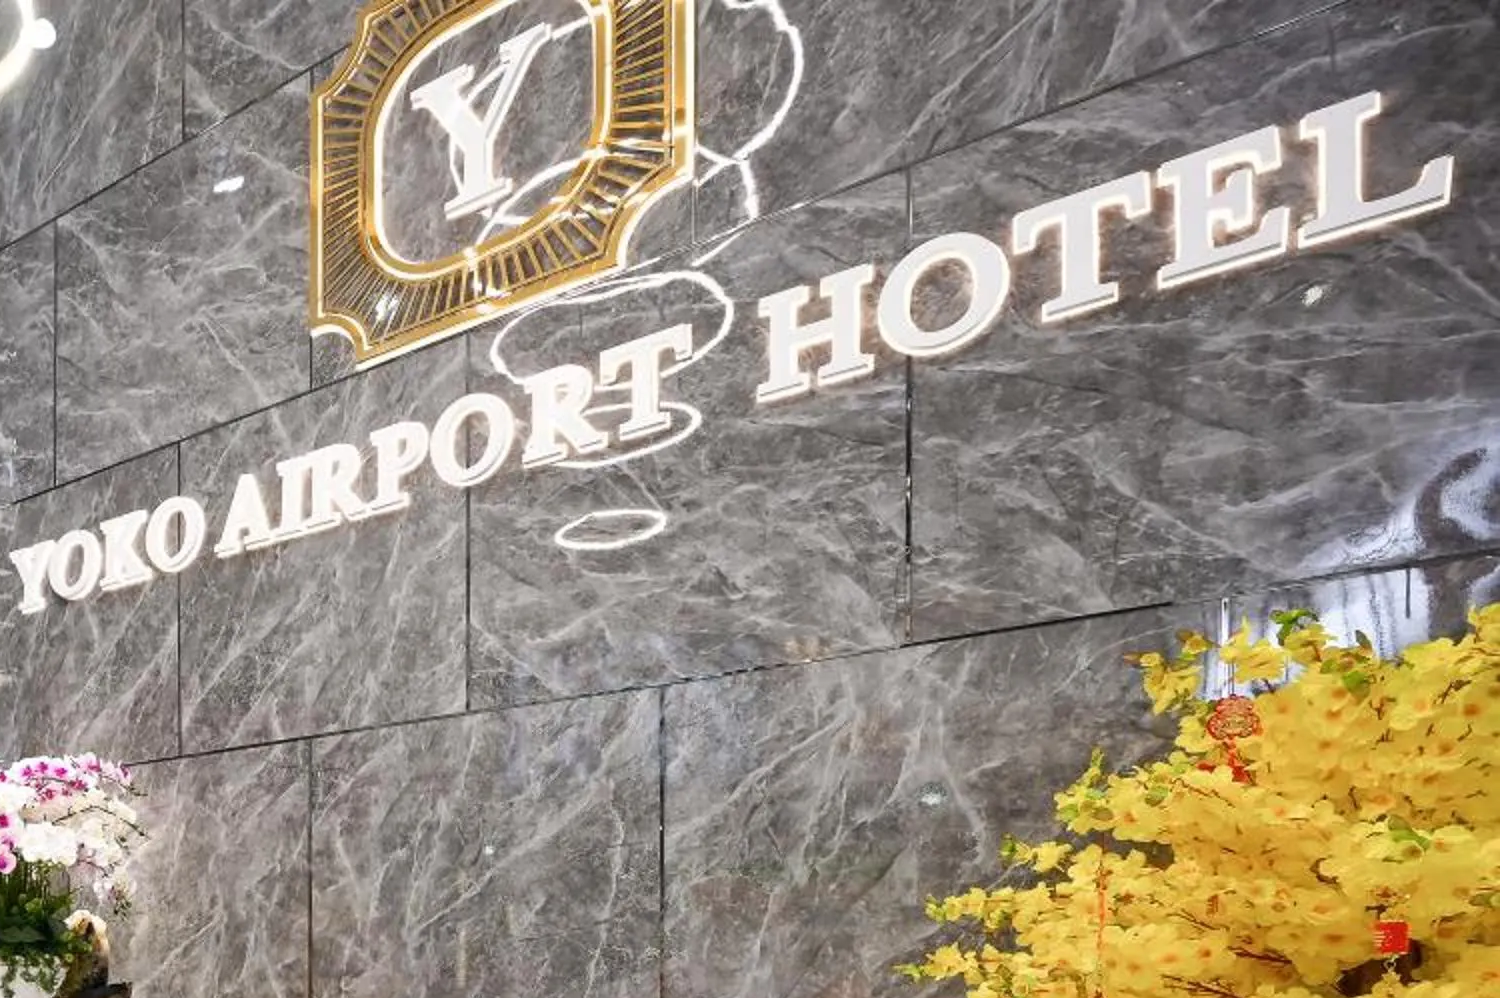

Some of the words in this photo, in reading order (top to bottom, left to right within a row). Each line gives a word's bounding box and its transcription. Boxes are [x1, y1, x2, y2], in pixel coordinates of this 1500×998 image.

[410, 21, 552, 221] Y
[10, 494, 207, 613] YOKO
[214, 322, 693, 559] AIRPORT
[756, 89, 1455, 402] HOTEL
